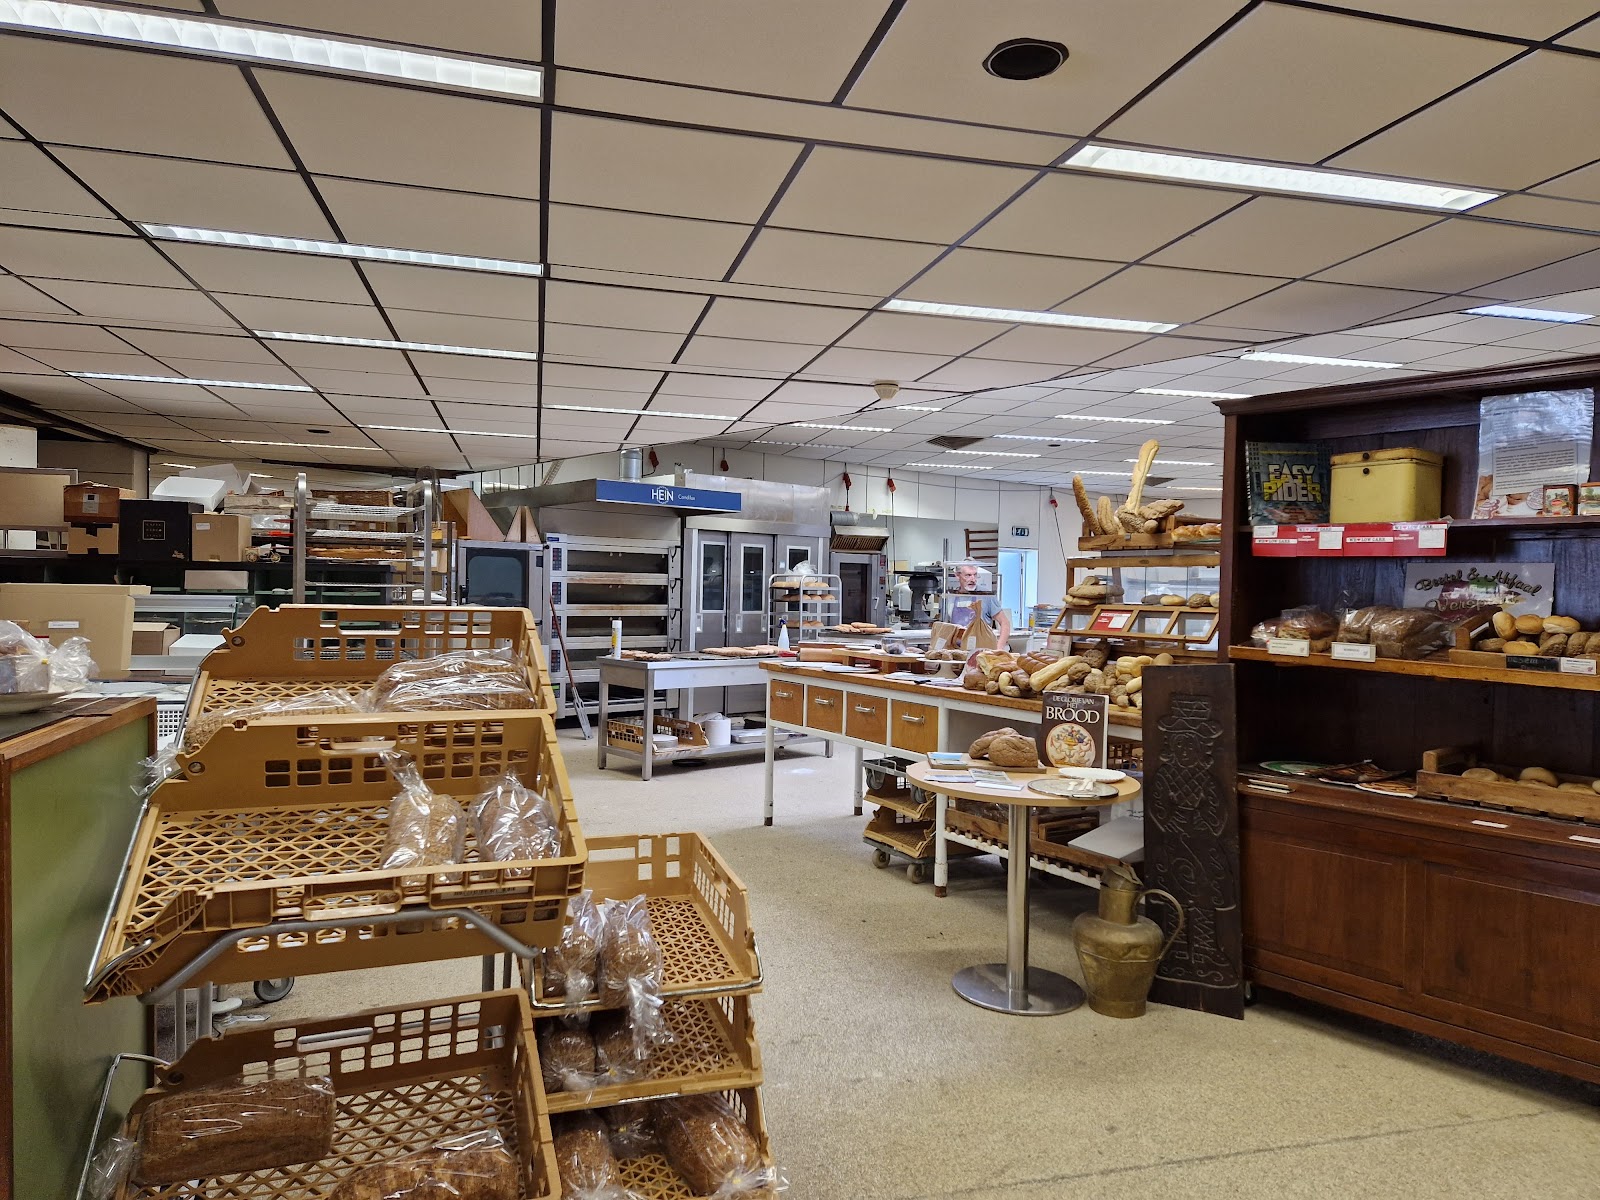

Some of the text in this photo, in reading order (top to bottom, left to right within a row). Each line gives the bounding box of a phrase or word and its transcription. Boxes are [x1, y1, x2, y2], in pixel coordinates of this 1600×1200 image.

[1268, 461, 1316, 482] EASY
[651, 489, 674, 501] HEIN
[1263, 481, 1322, 503] RIDER
[1467, 567, 1480, 582] &
[1060, 696, 1082, 704] GLORIE
[1045, 706, 1100, 723] BROOD
